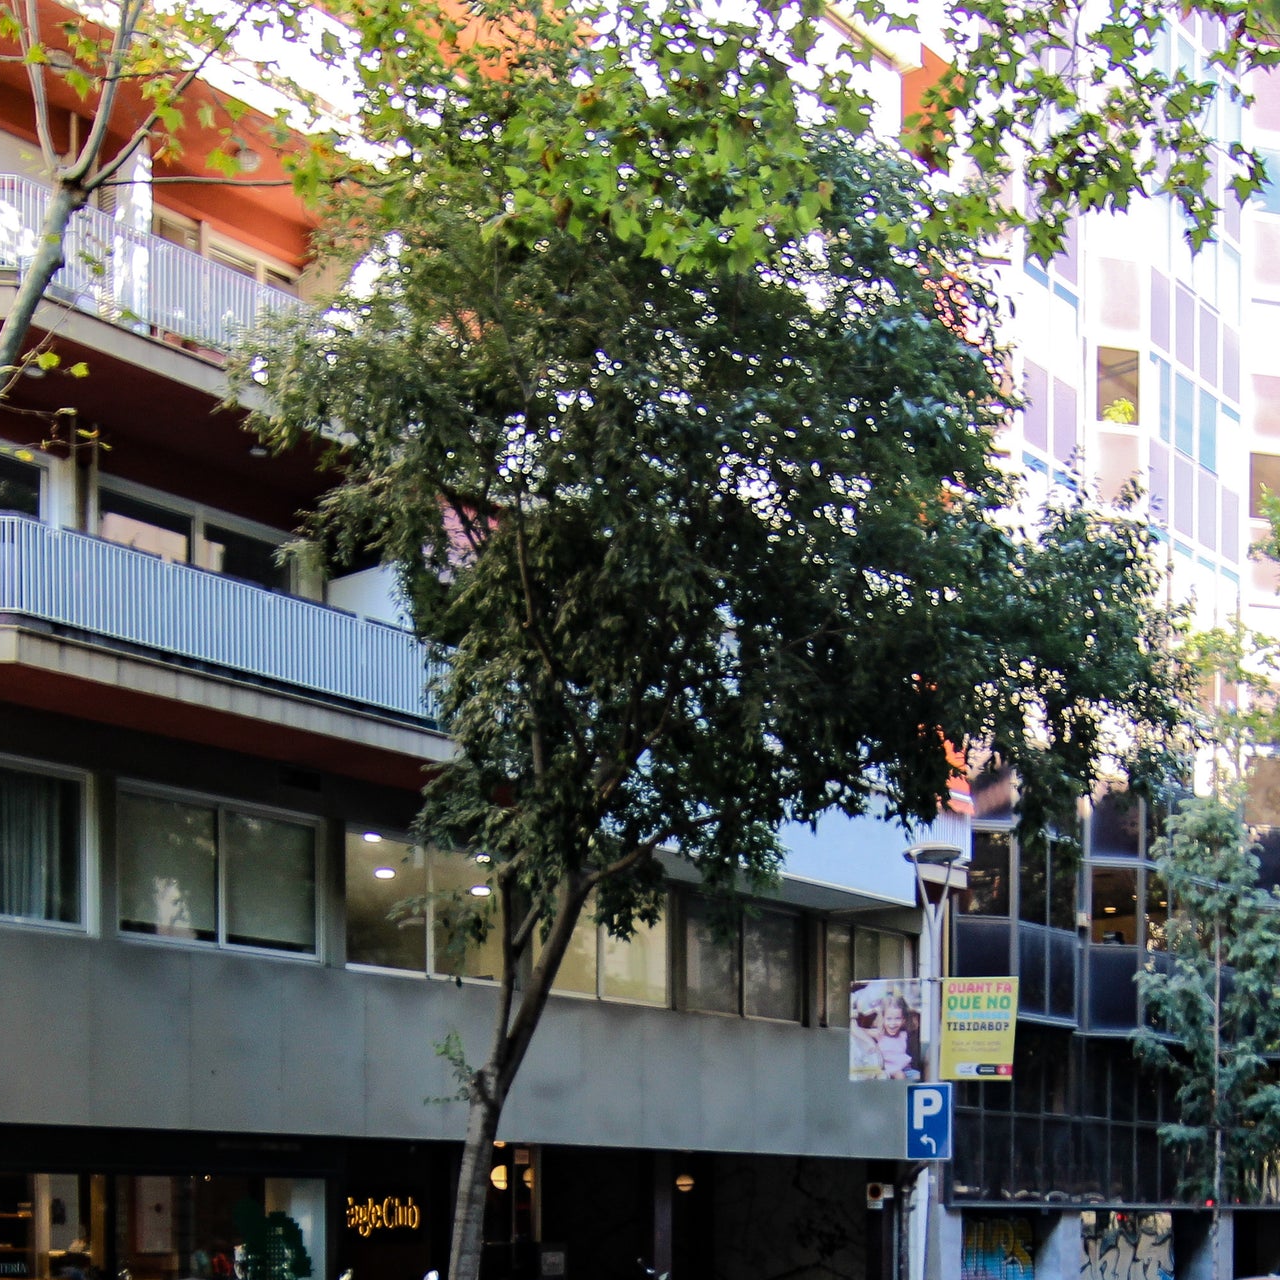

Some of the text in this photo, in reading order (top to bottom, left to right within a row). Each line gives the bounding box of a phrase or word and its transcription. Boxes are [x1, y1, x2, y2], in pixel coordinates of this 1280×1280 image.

[948, 982, 1012, 995] QUANT FA
[947, 995, 1011, 1010] QUE NO
[947, 1021, 1009, 1032] TIBIDABO?
[913, 1088, 943, 1130] P
